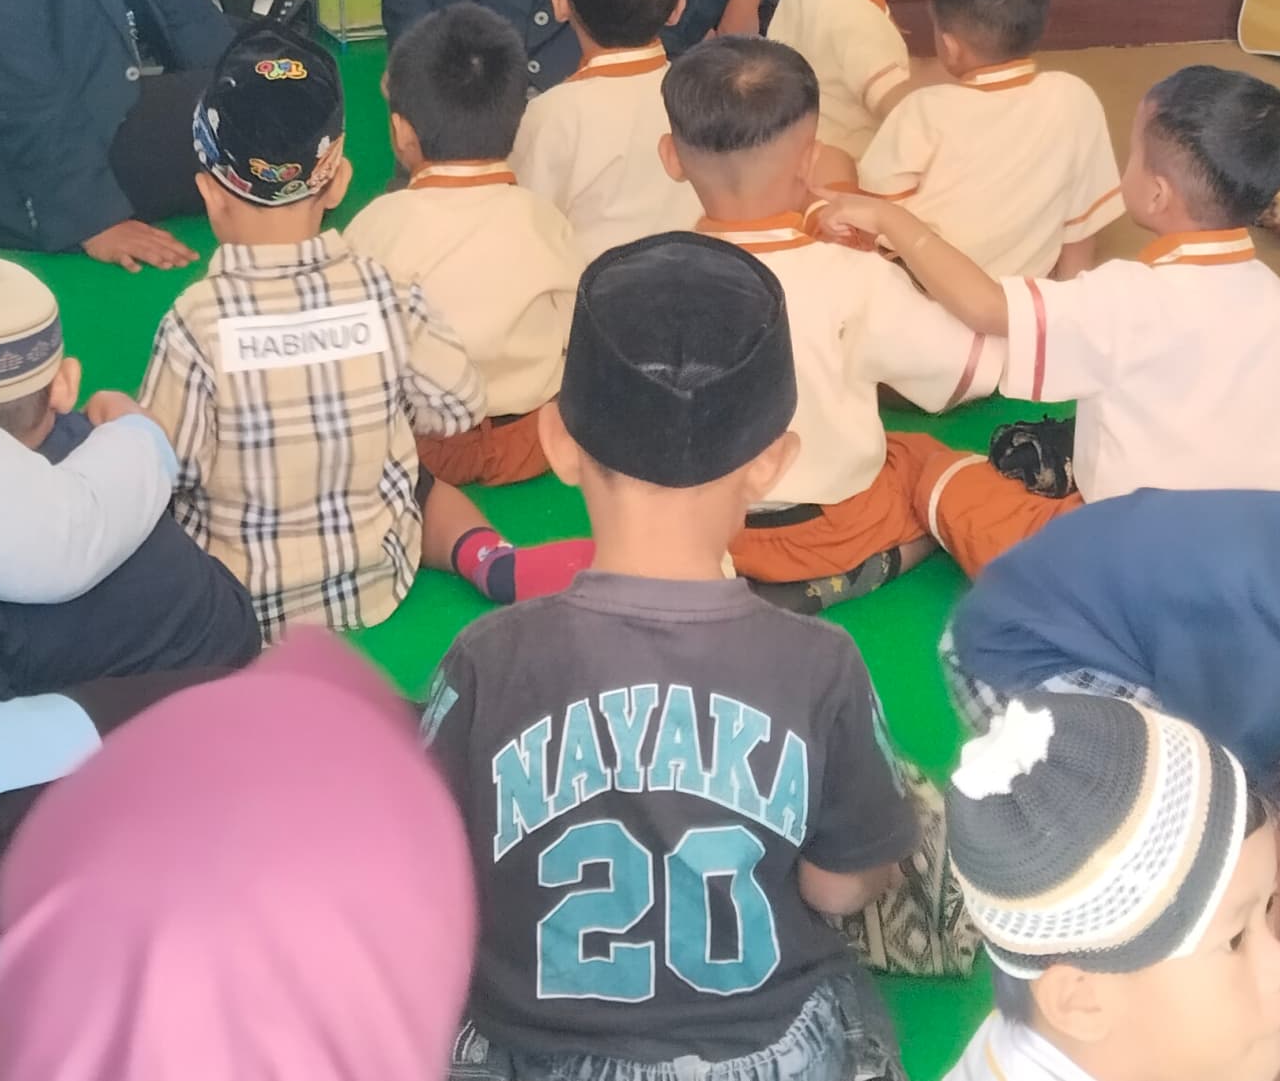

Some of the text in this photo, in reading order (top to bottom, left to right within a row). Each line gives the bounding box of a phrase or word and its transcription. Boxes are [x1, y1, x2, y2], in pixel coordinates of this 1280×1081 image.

[237, 321, 372, 361] HABINUO
[492, 684, 809, 864] NAYAKA
[536, 818, 781, 1004] 20
